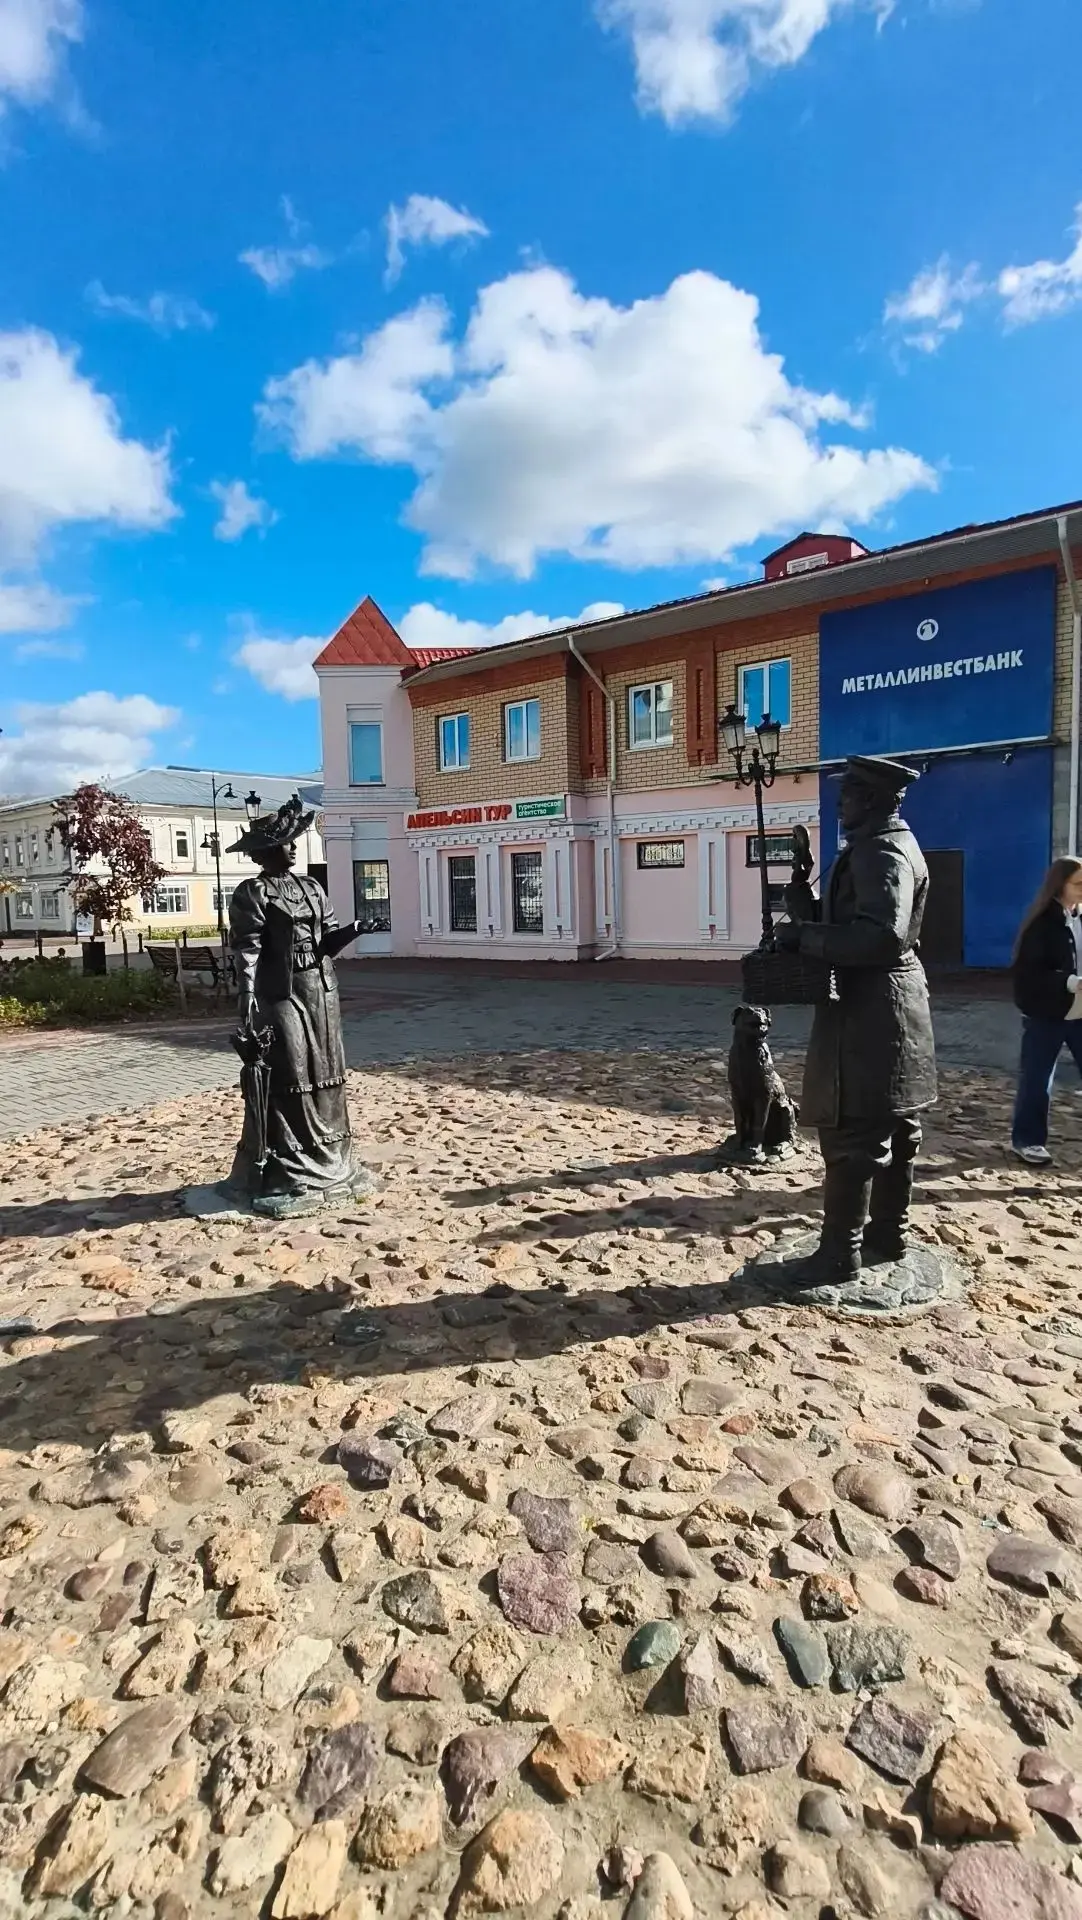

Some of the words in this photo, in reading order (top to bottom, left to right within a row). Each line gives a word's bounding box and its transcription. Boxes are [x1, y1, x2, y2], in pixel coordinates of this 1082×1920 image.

[842, 649, 1023, 694] МЕТАЛЛИНВЕСТБАНК
[407, 808, 482, 829] АПЕЛЬСИН
[484, 805, 512, 822] ТУР
